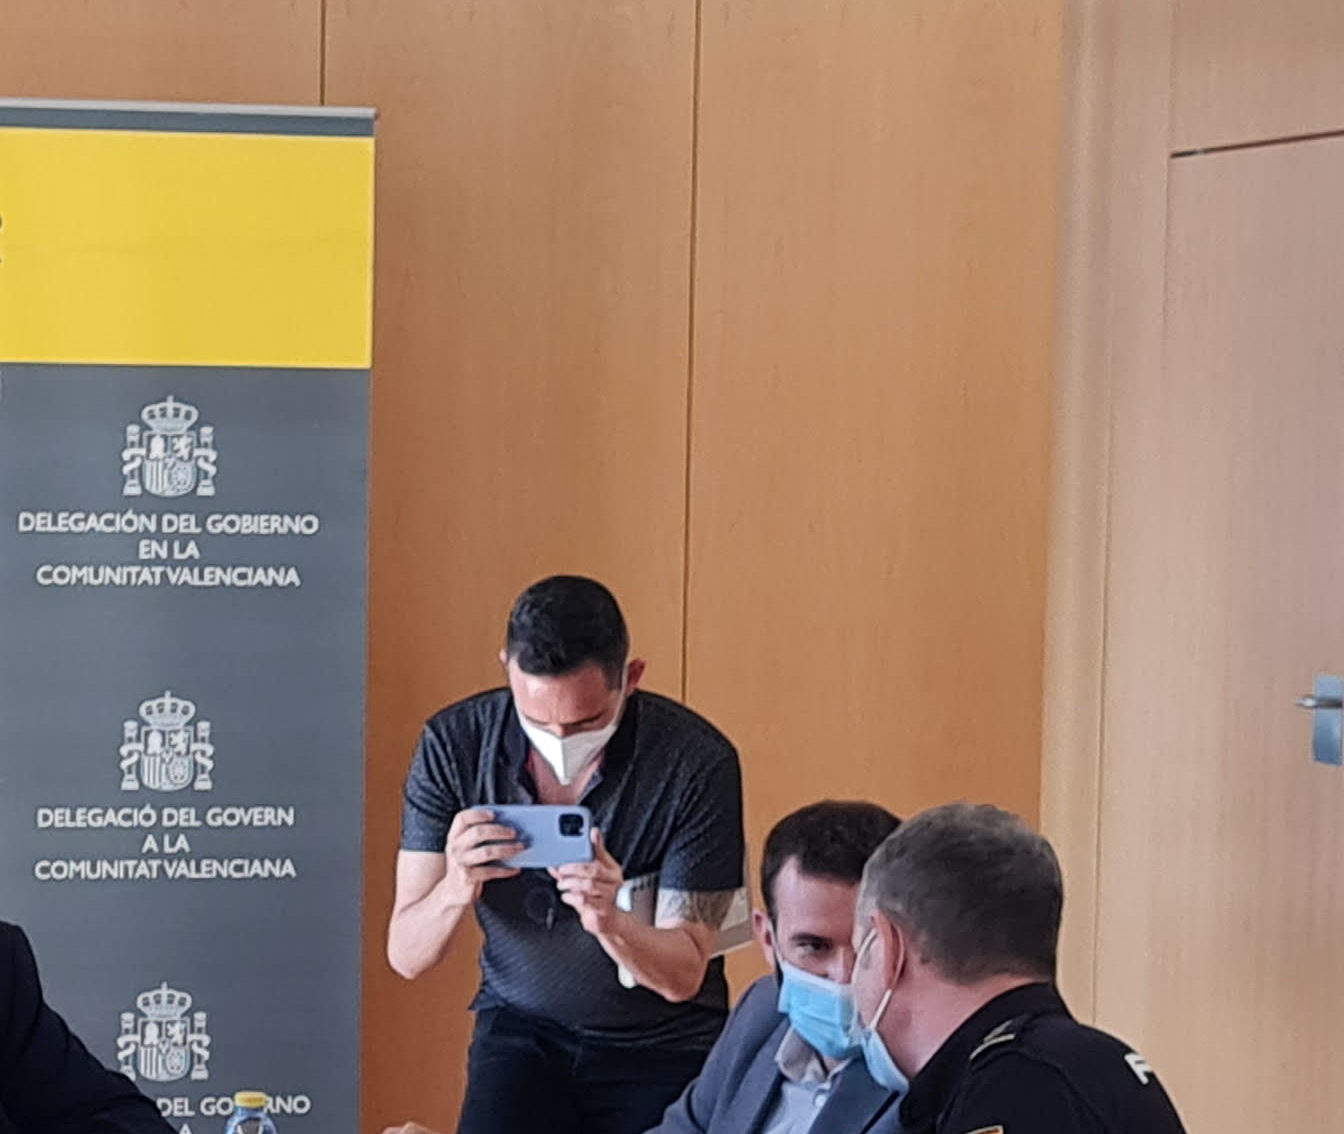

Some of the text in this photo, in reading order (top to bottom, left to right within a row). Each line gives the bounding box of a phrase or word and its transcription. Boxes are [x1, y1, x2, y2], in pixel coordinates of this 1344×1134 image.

[17, 508, 320, 535] DELEGACIÓN DEL GOBIERNO
[138, 539, 201, 560] EN LA
[35, 564, 302, 587] COMUNITAT VALENCIANA
[36, 803, 295, 828] DELEGACIÓ DEL GOVERN
[141, 833, 191, 854] A LA
[34, 858, 297, 881] COMUNITAT VALENCIANA
[157, 1095, 312, 1117] DEL GORNO
